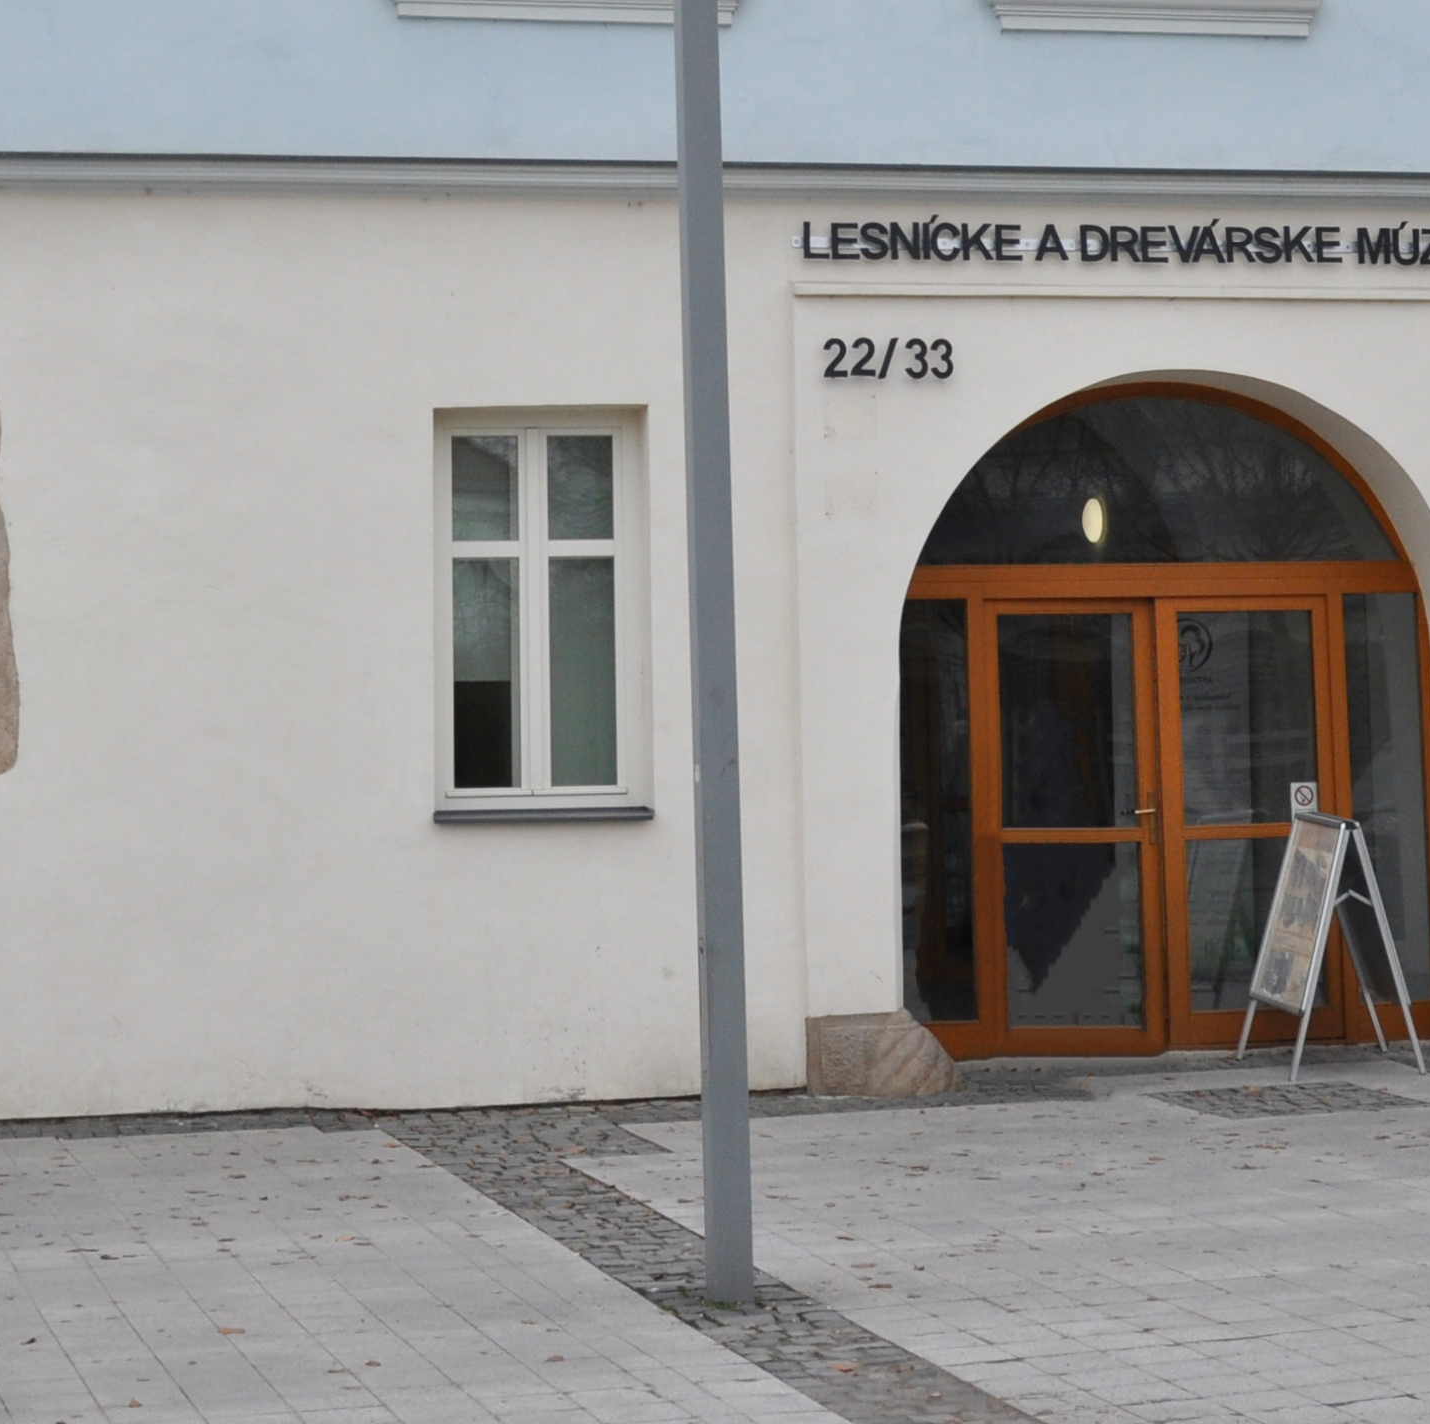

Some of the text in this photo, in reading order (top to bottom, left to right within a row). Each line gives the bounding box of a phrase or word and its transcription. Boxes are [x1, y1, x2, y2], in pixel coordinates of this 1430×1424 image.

[803, 214, 1024, 261] LESNÍCKE
[1034, 223, 1070, 261] A
[1079, 218, 1343, 264] DREVÁRSKE
[823, 337, 954, 380] 22/33
